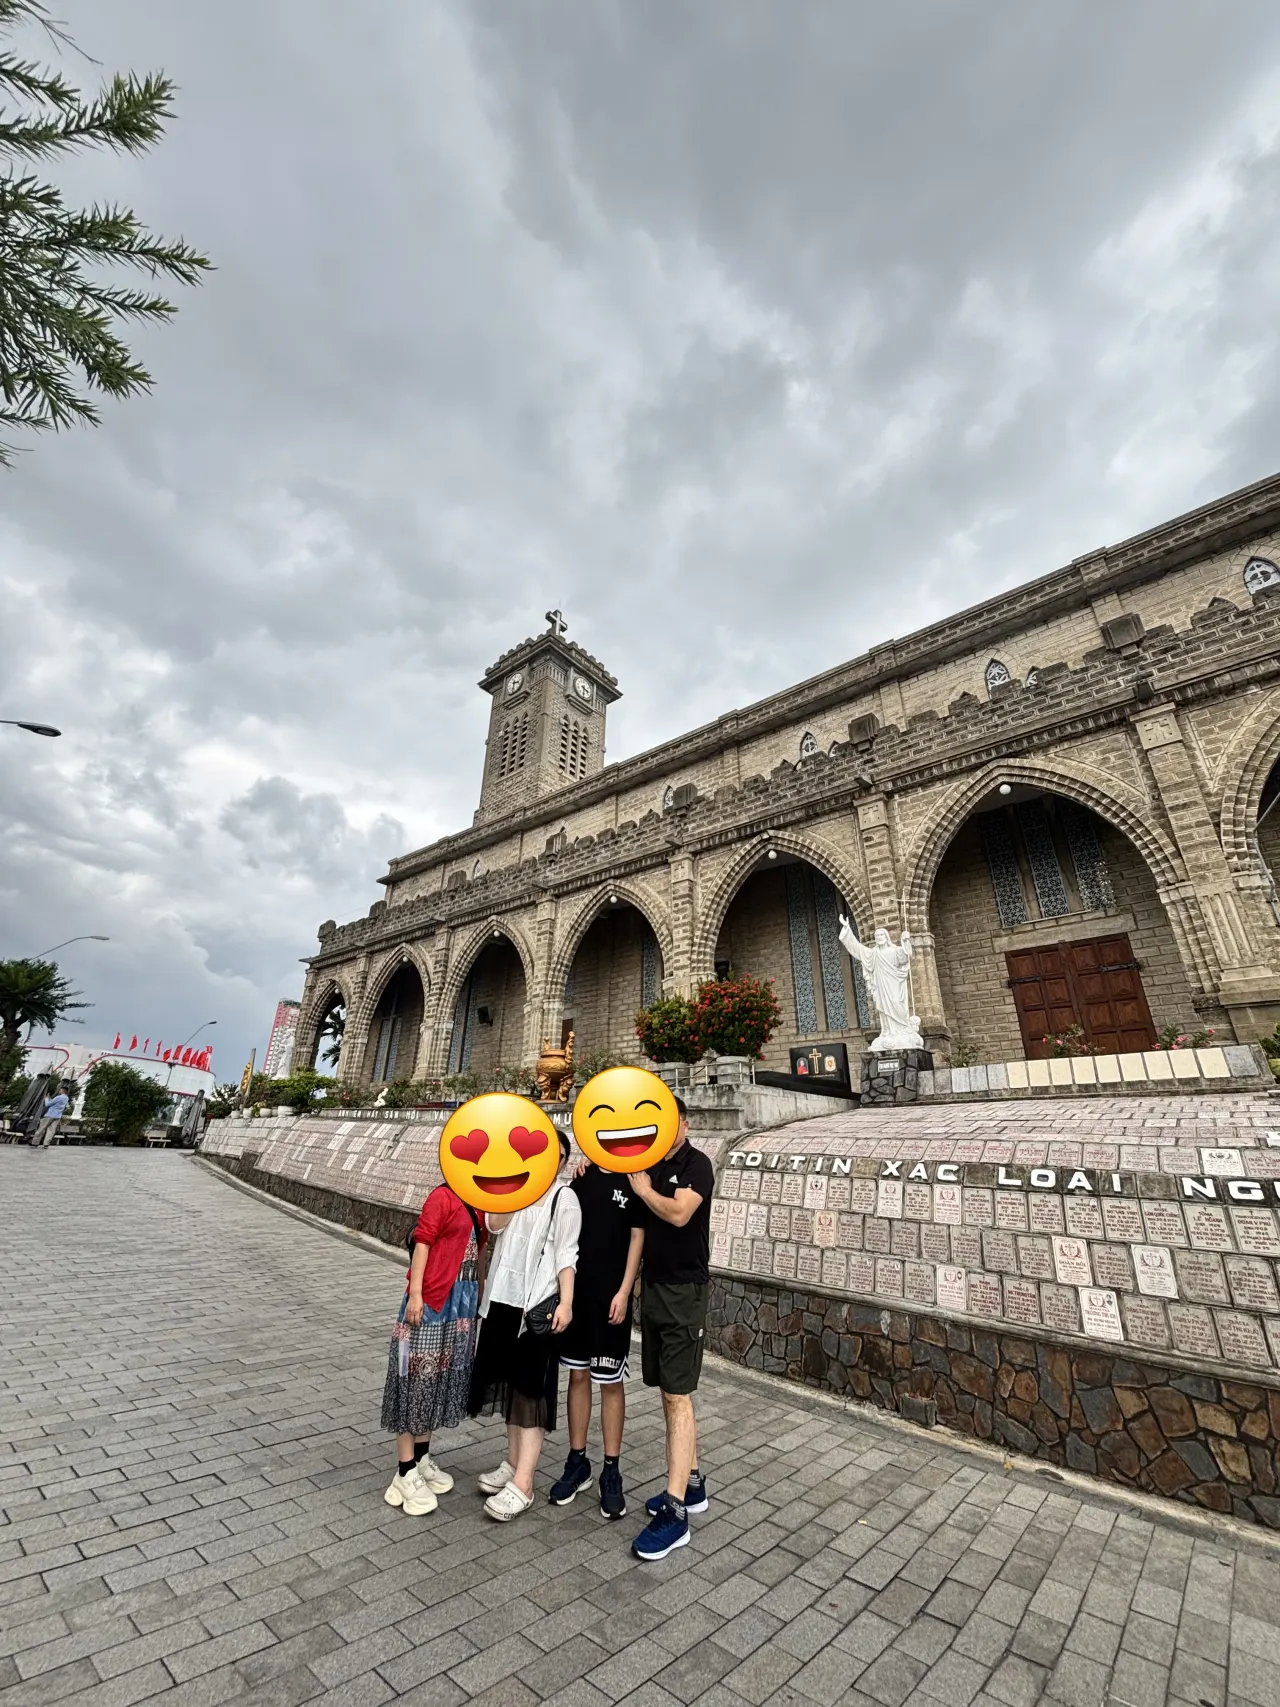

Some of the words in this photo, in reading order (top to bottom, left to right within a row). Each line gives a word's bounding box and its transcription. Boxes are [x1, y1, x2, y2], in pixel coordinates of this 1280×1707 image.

[790, 1156, 852, 1174] TIN
[1182, 1176, 1280, 1201] NG
[612, 1189, 628, 1209] NY
